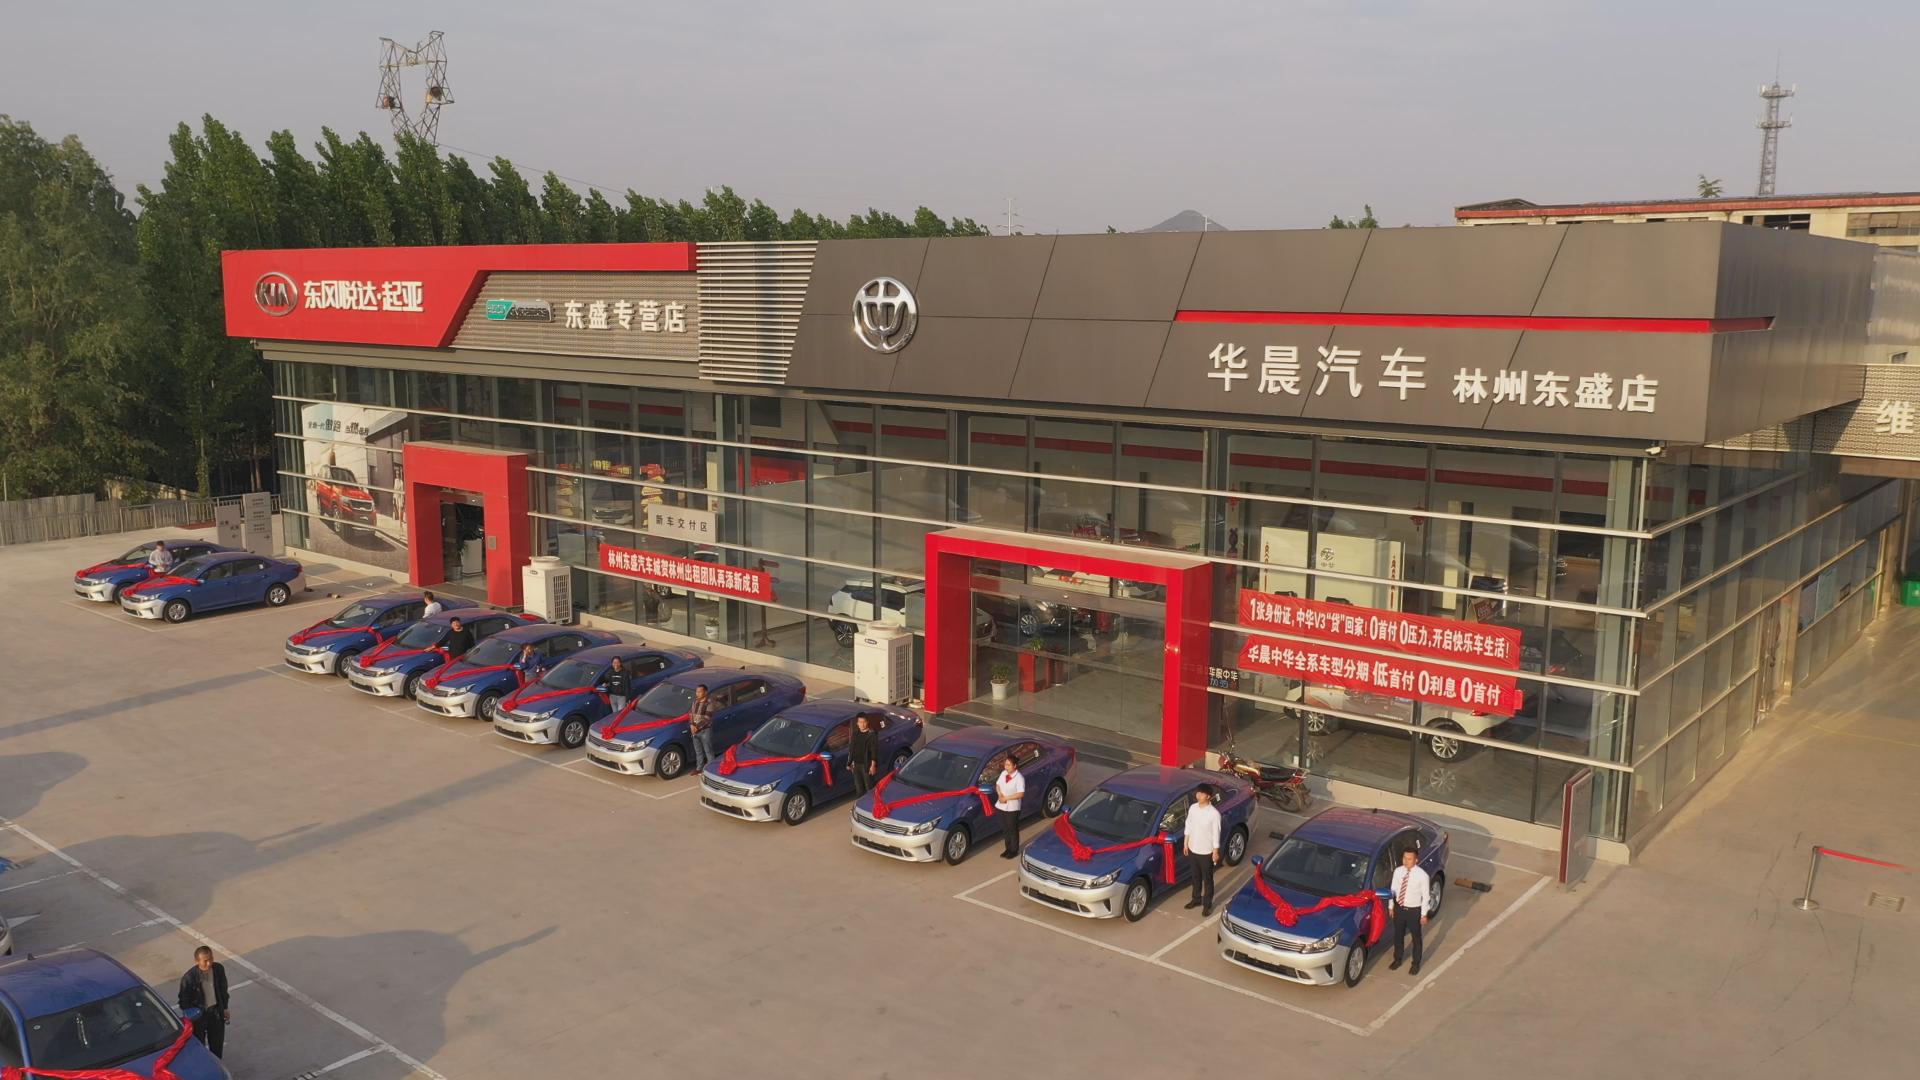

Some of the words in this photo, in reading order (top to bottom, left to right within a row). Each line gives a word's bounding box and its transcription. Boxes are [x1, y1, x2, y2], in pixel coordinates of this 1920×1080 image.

[256, 279, 293, 309] KIA
[303, 280, 424, 312] 东风悦达·起亚
[564, 299, 686, 332] 东盛专营店
[1207, 343, 1426, 400] 华晨汽车
[1452, 367, 1659, 413] 林州东盛店
[1875, 400, 1915, 434] 维
[655, 514, 708, 532] 新车交付区
[607, 549, 760, 594] 林州东盛汽车城贺林州出租团队再添新成员
